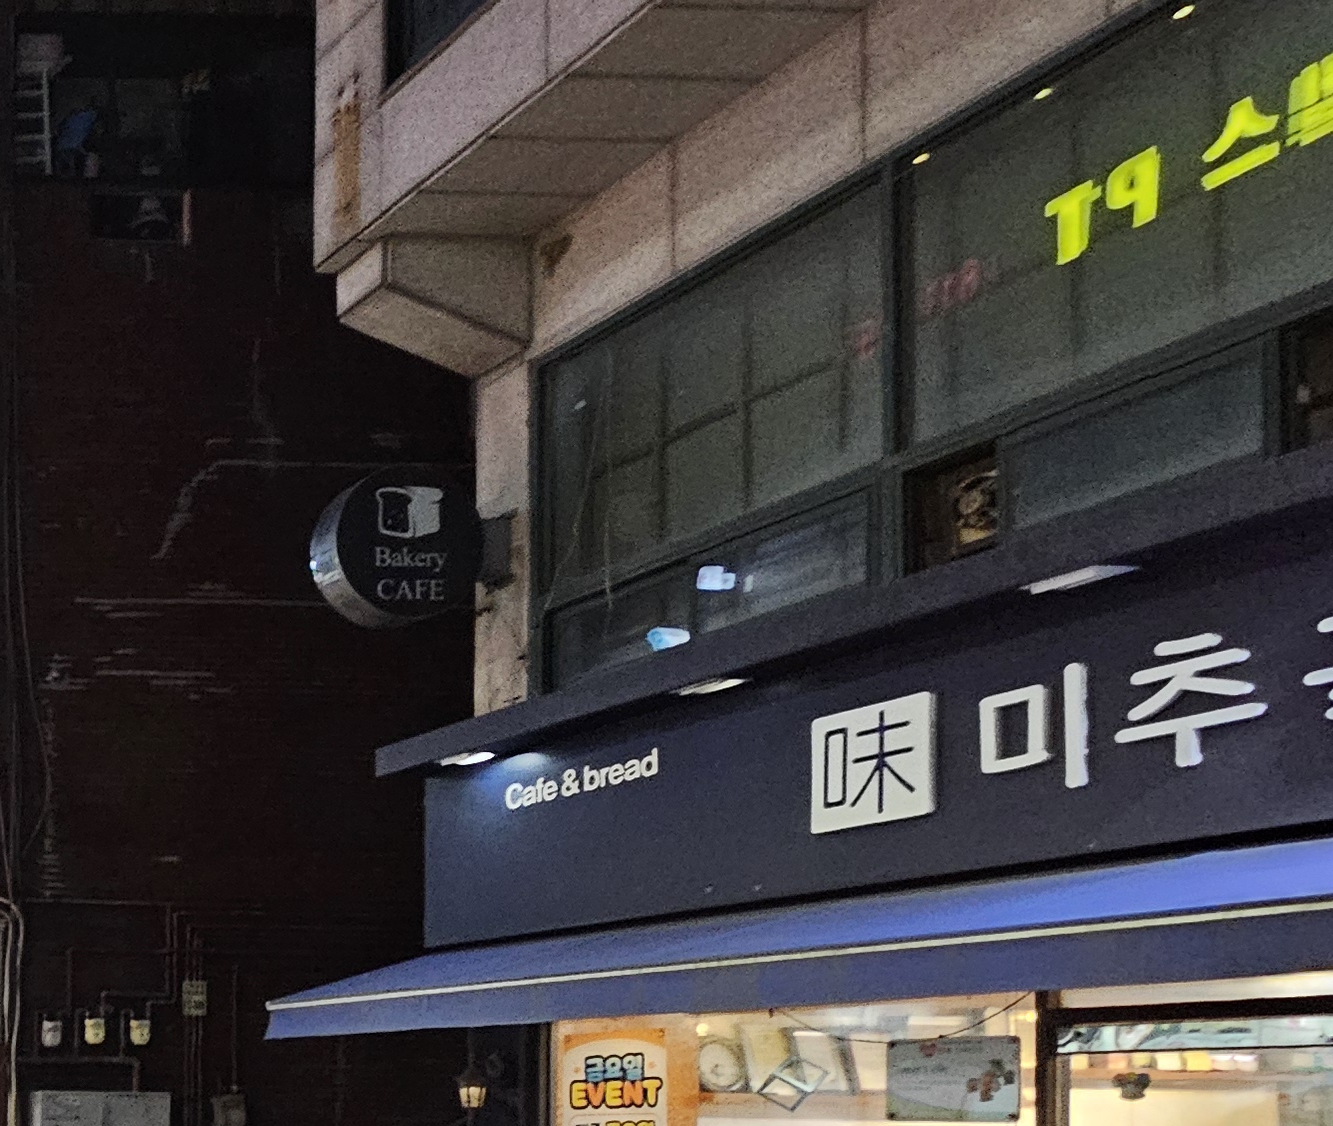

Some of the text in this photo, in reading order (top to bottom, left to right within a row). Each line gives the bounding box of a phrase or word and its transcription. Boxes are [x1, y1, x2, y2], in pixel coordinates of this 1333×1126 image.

[374, 545, 448, 571] Bakery
[376, 578, 447, 601] CAFE
[979, 615, 1333, 788] 미추
[822, 709, 916, 814] 味
[504, 747, 660, 811] Cafe & bread
[585, 1052, 645, 1083] 금요일
[569, 1077, 663, 1110] EVENT
